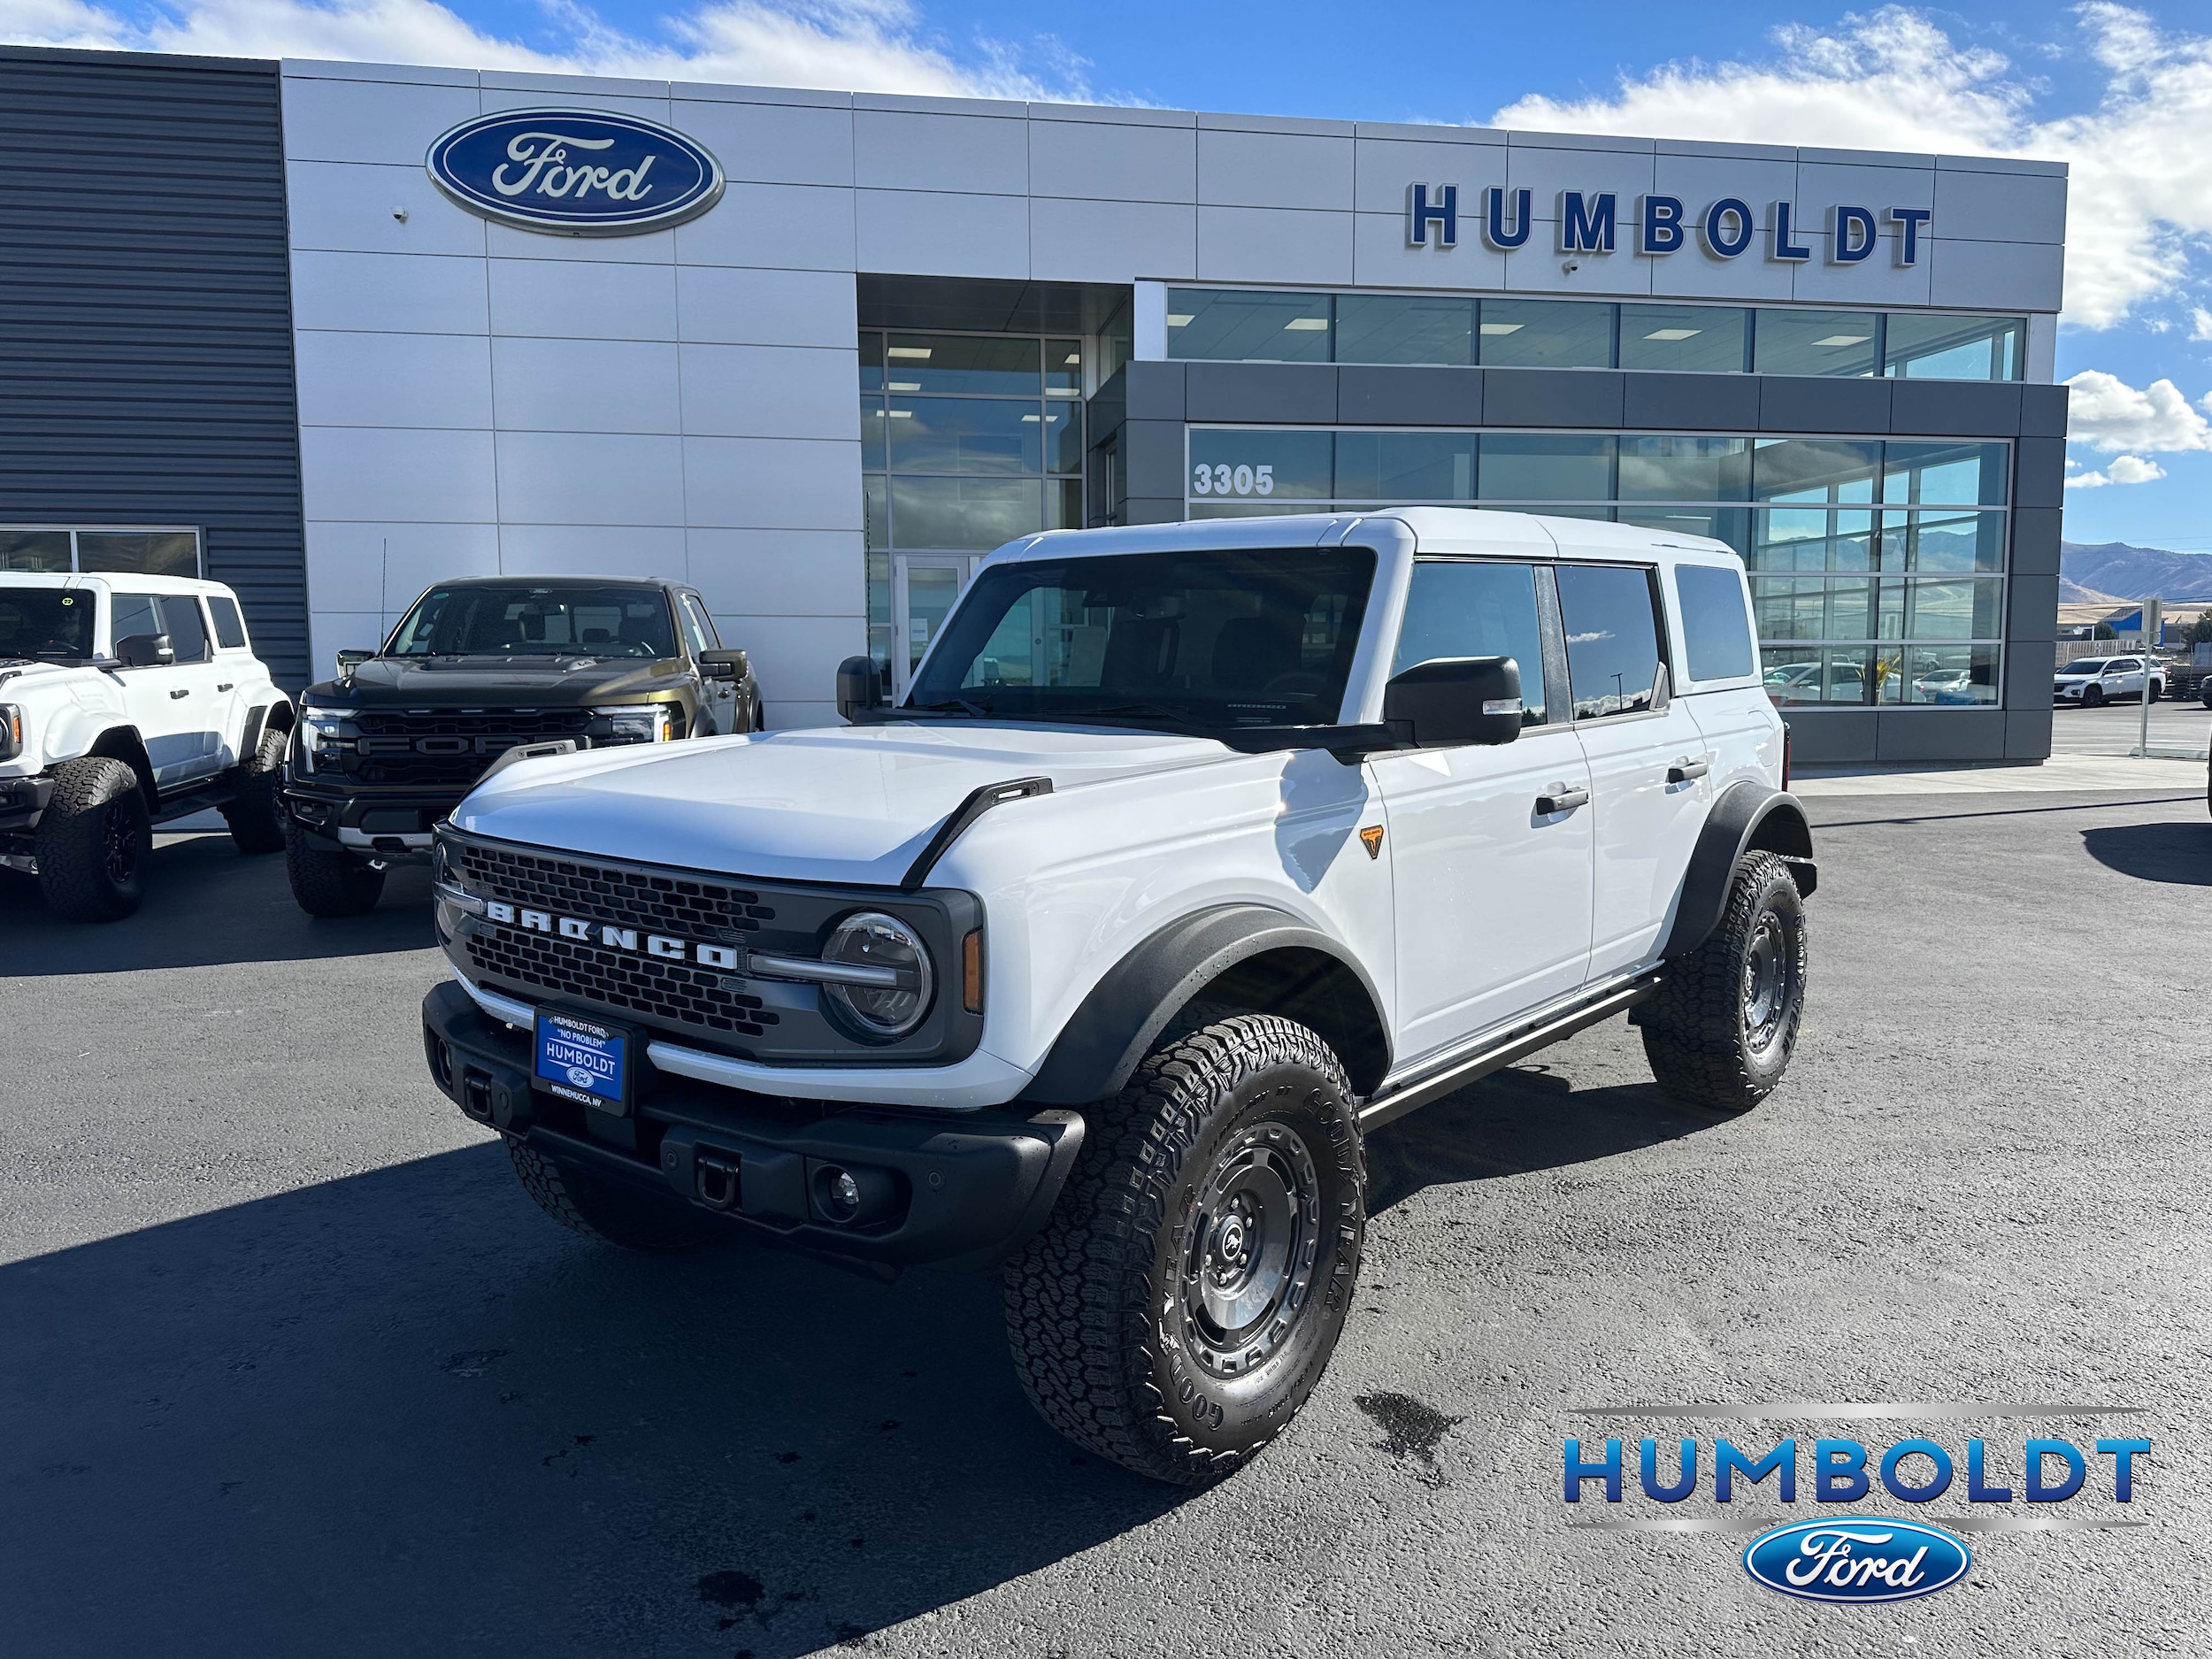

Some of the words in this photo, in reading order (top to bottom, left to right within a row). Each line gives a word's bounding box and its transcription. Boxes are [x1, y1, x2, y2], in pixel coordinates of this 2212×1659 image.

[491, 132, 657, 201] Ford
[1407, 181, 1932, 267] HUMBOLDT
[1194, 463, 1274, 495] 3305
[488, 901, 738, 970] BRONCO
[554, 1015, 589, 1033] HUMBOLDT
[547, 1042, 616, 1075] HUMBOLDT
[572, 1070, 588, 1084] Ford
[551, 1084, 591, 1105] WINNEMUCCA,
[592, 1097, 602, 1108] NV
